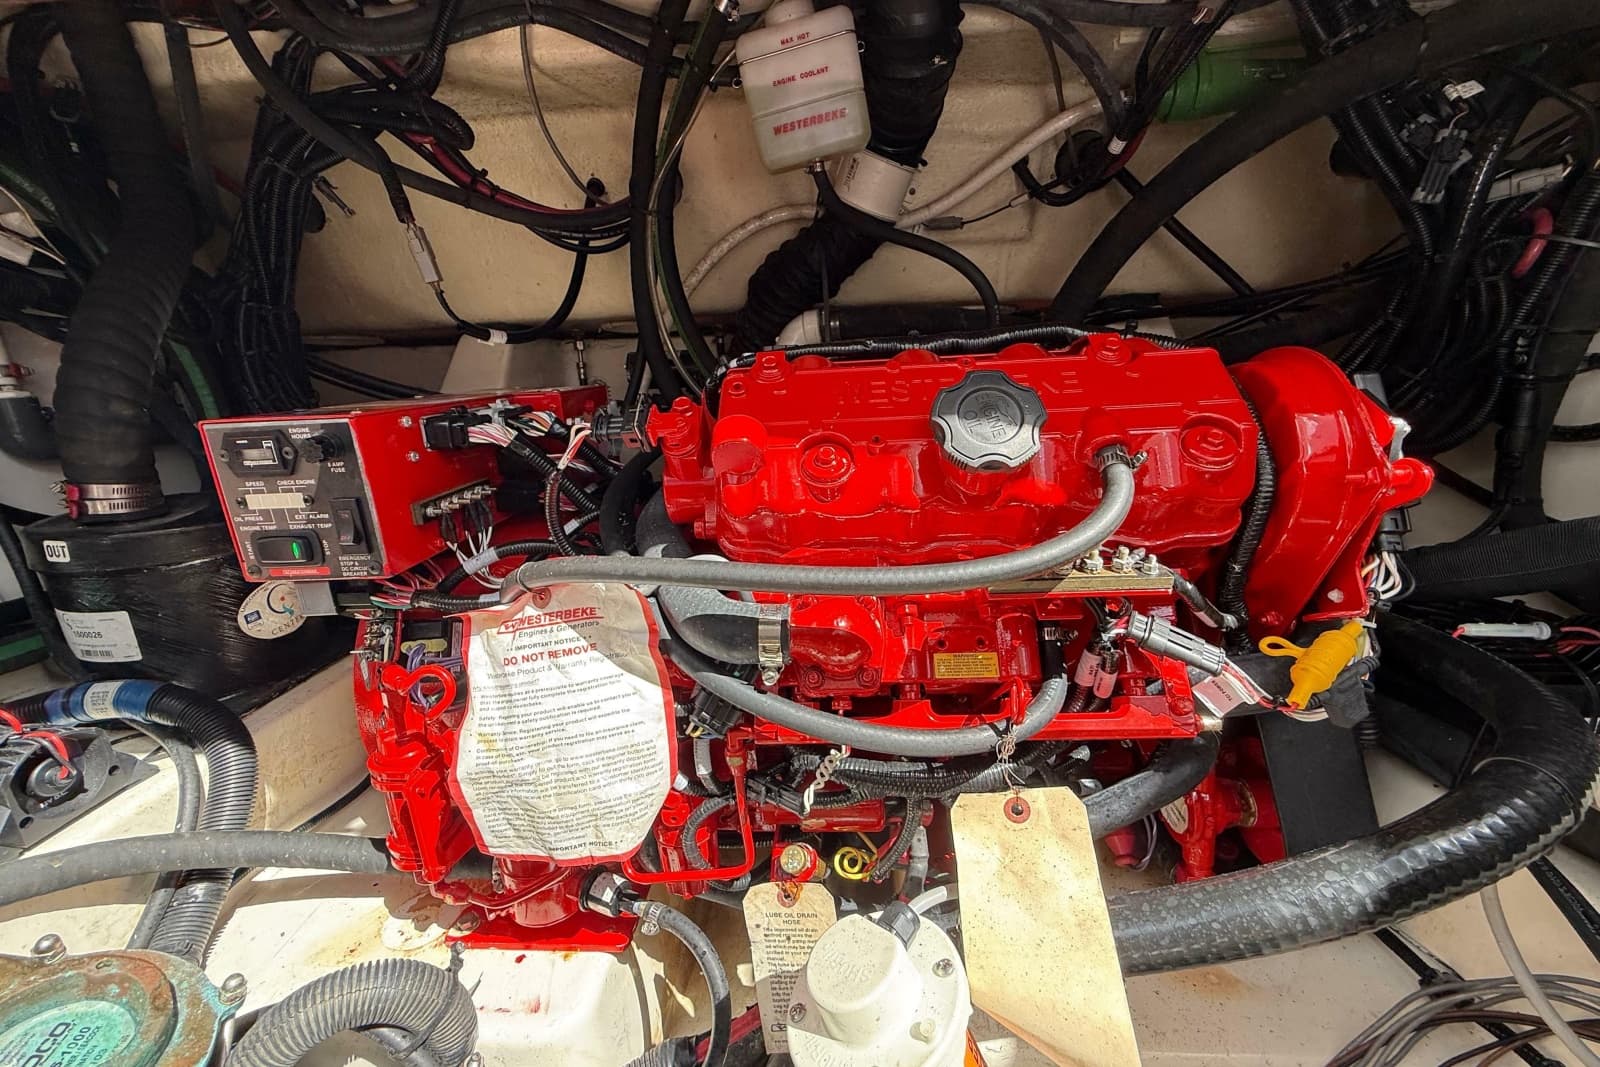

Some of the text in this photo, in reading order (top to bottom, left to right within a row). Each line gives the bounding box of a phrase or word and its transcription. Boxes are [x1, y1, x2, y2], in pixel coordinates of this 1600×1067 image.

[780, 32, 810, 45] MAX HOT
[773, 66, 829, 87] ENGINE COOLANT
[772, 107, 848, 136] WESTERBEKE
[964, 410, 982, 434] OIL
[46, 544, 68, 559] OUT
[518, 607, 598, 628] WESTERBEKE
[518, 629, 548, 639] Engines
[556, 621, 600, 633] Generators
[515, 637, 581, 652] IMPORTANT NOTICE
[504, 643, 598, 666] DO NOT REMOVE
[517, 665, 546, 676] Product
[553, 660, 587, 671] Warranty
